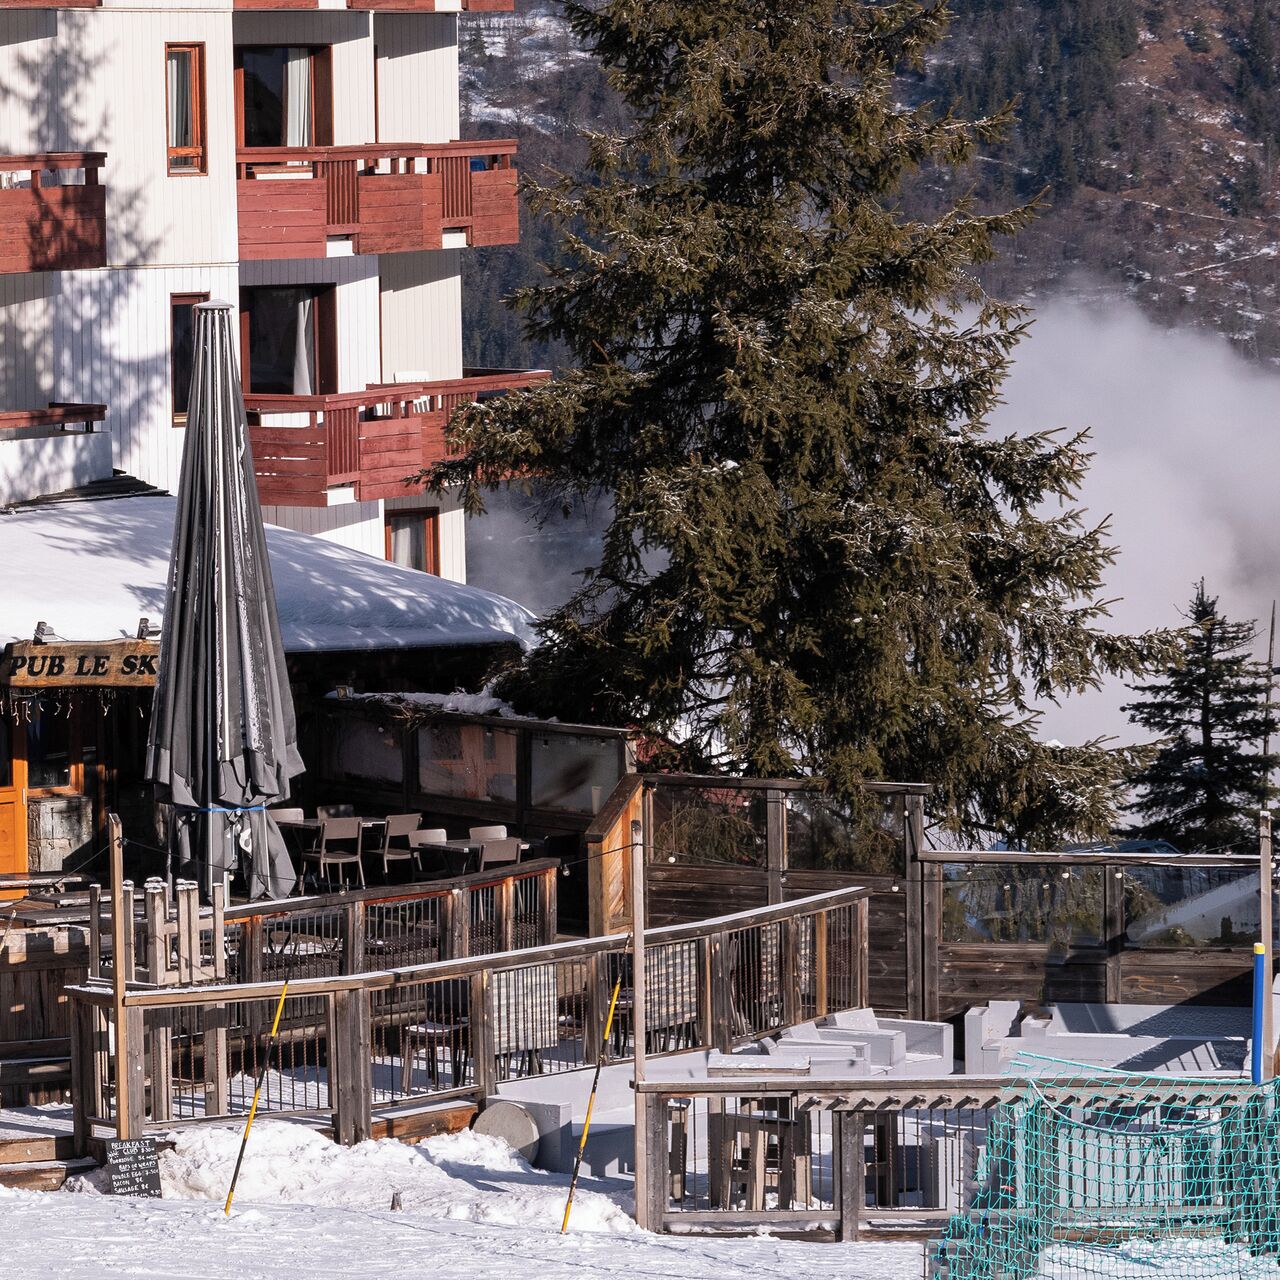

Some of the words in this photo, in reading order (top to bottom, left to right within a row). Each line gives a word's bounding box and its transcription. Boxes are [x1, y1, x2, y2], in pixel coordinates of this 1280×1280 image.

[8, 655, 66, 677] PUB
[74, 655, 110, 677] LE
[121, 654, 159, 676] SK
[111, 1140, 151, 1150] BREAKFAST
